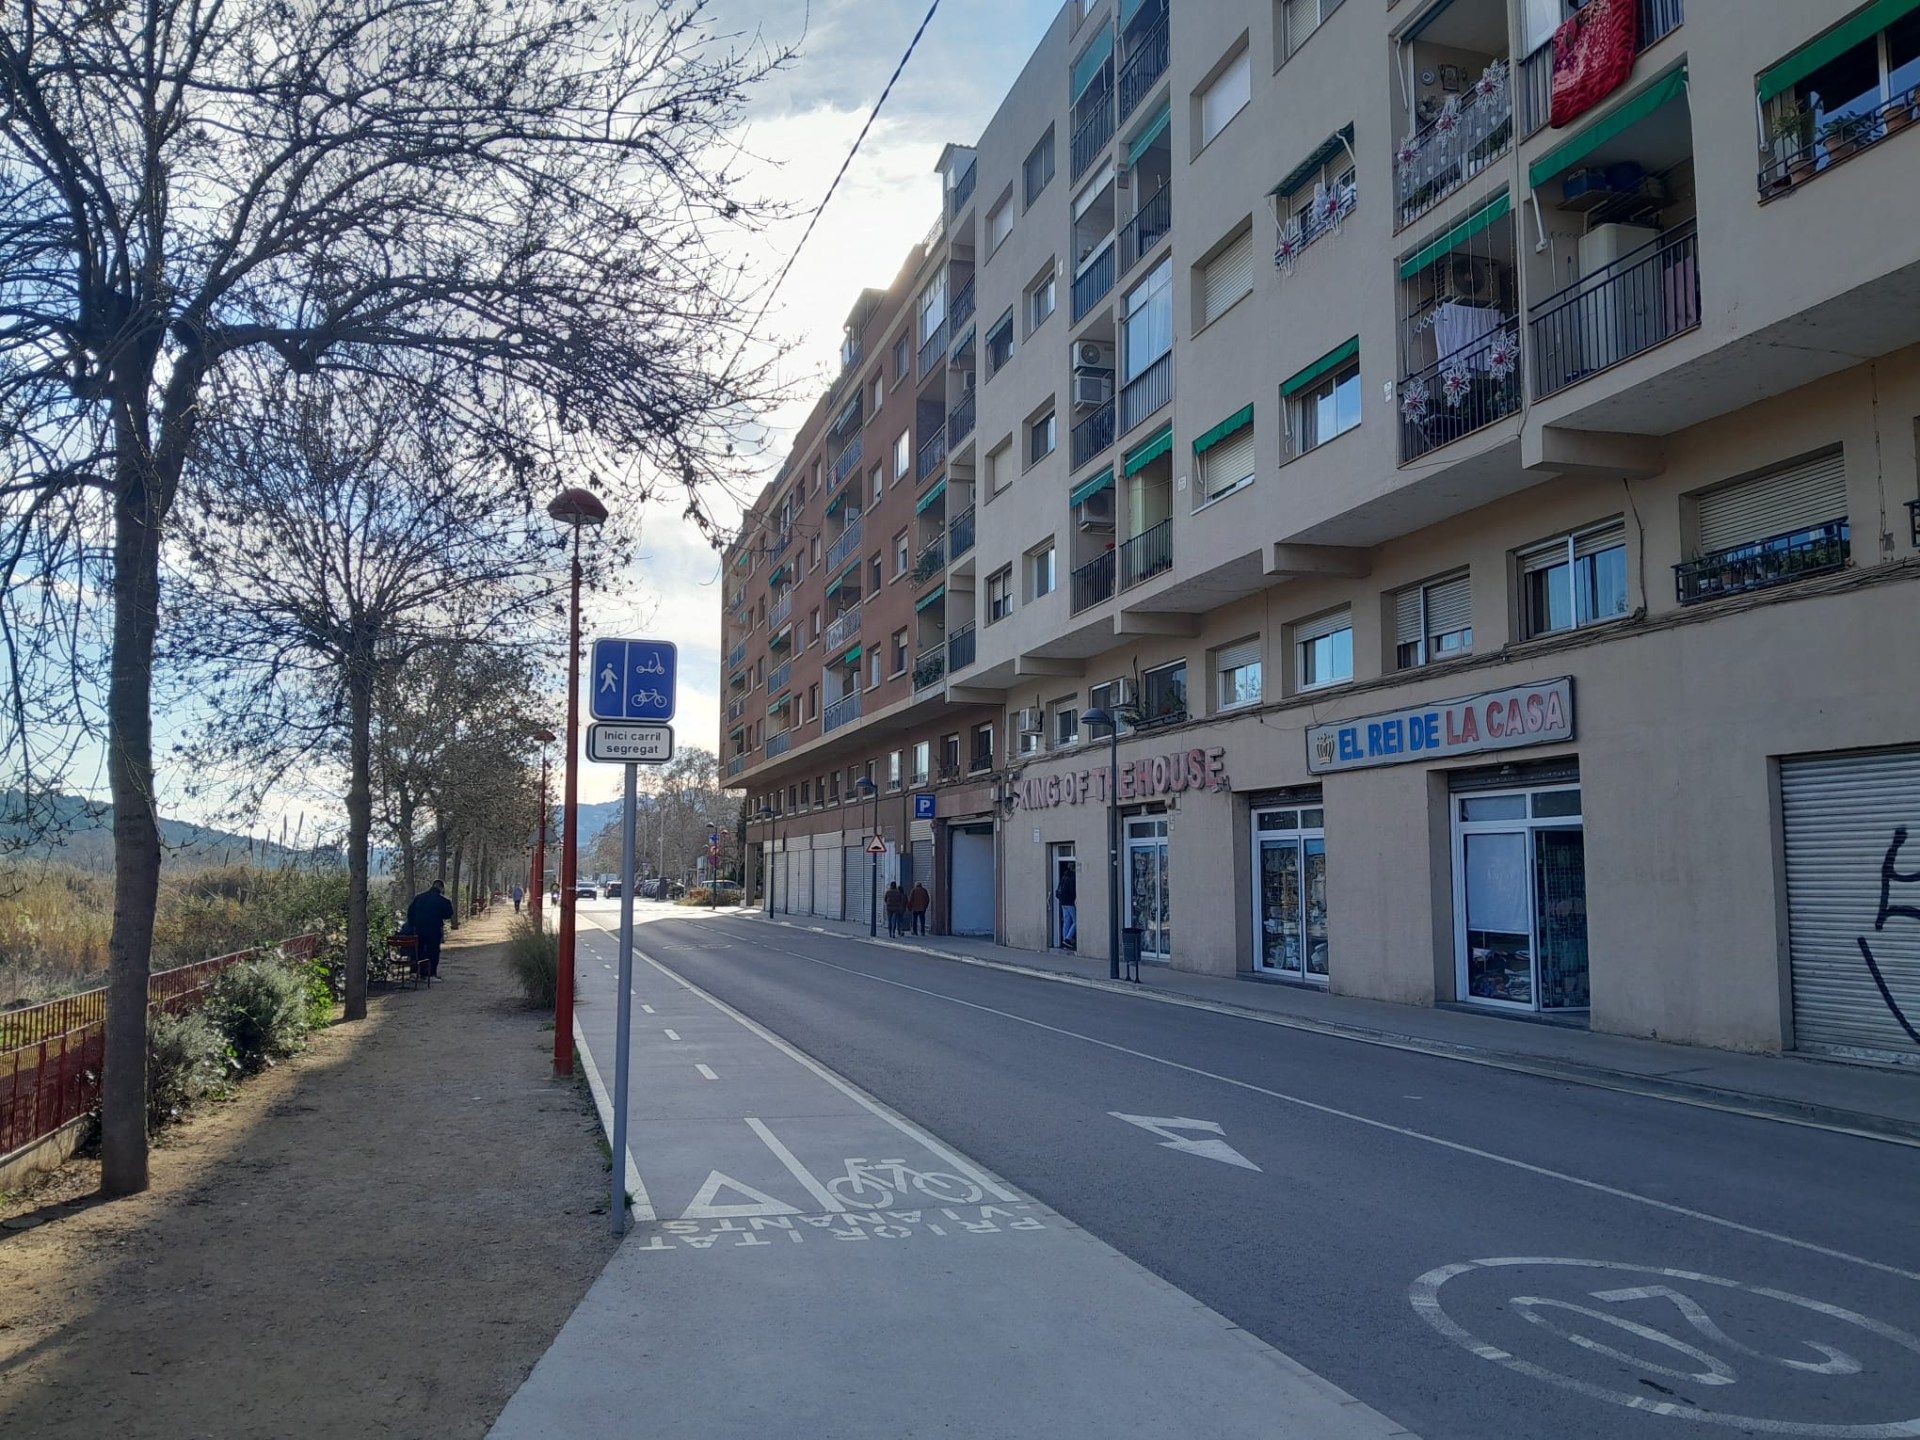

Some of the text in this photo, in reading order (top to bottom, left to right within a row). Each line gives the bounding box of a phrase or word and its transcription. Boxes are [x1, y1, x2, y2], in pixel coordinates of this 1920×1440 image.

[1338, 690, 1565, 761] EL REI DE LA CASA
[604, 731, 661, 741] Inici carril
[606, 745, 658, 756] segregat
[1019, 774, 1060, 811] KING
[1064, 770, 1089, 805] OF
[1135, 747, 1224, 795] HOUSE
[919, 799, 931, 812] P
